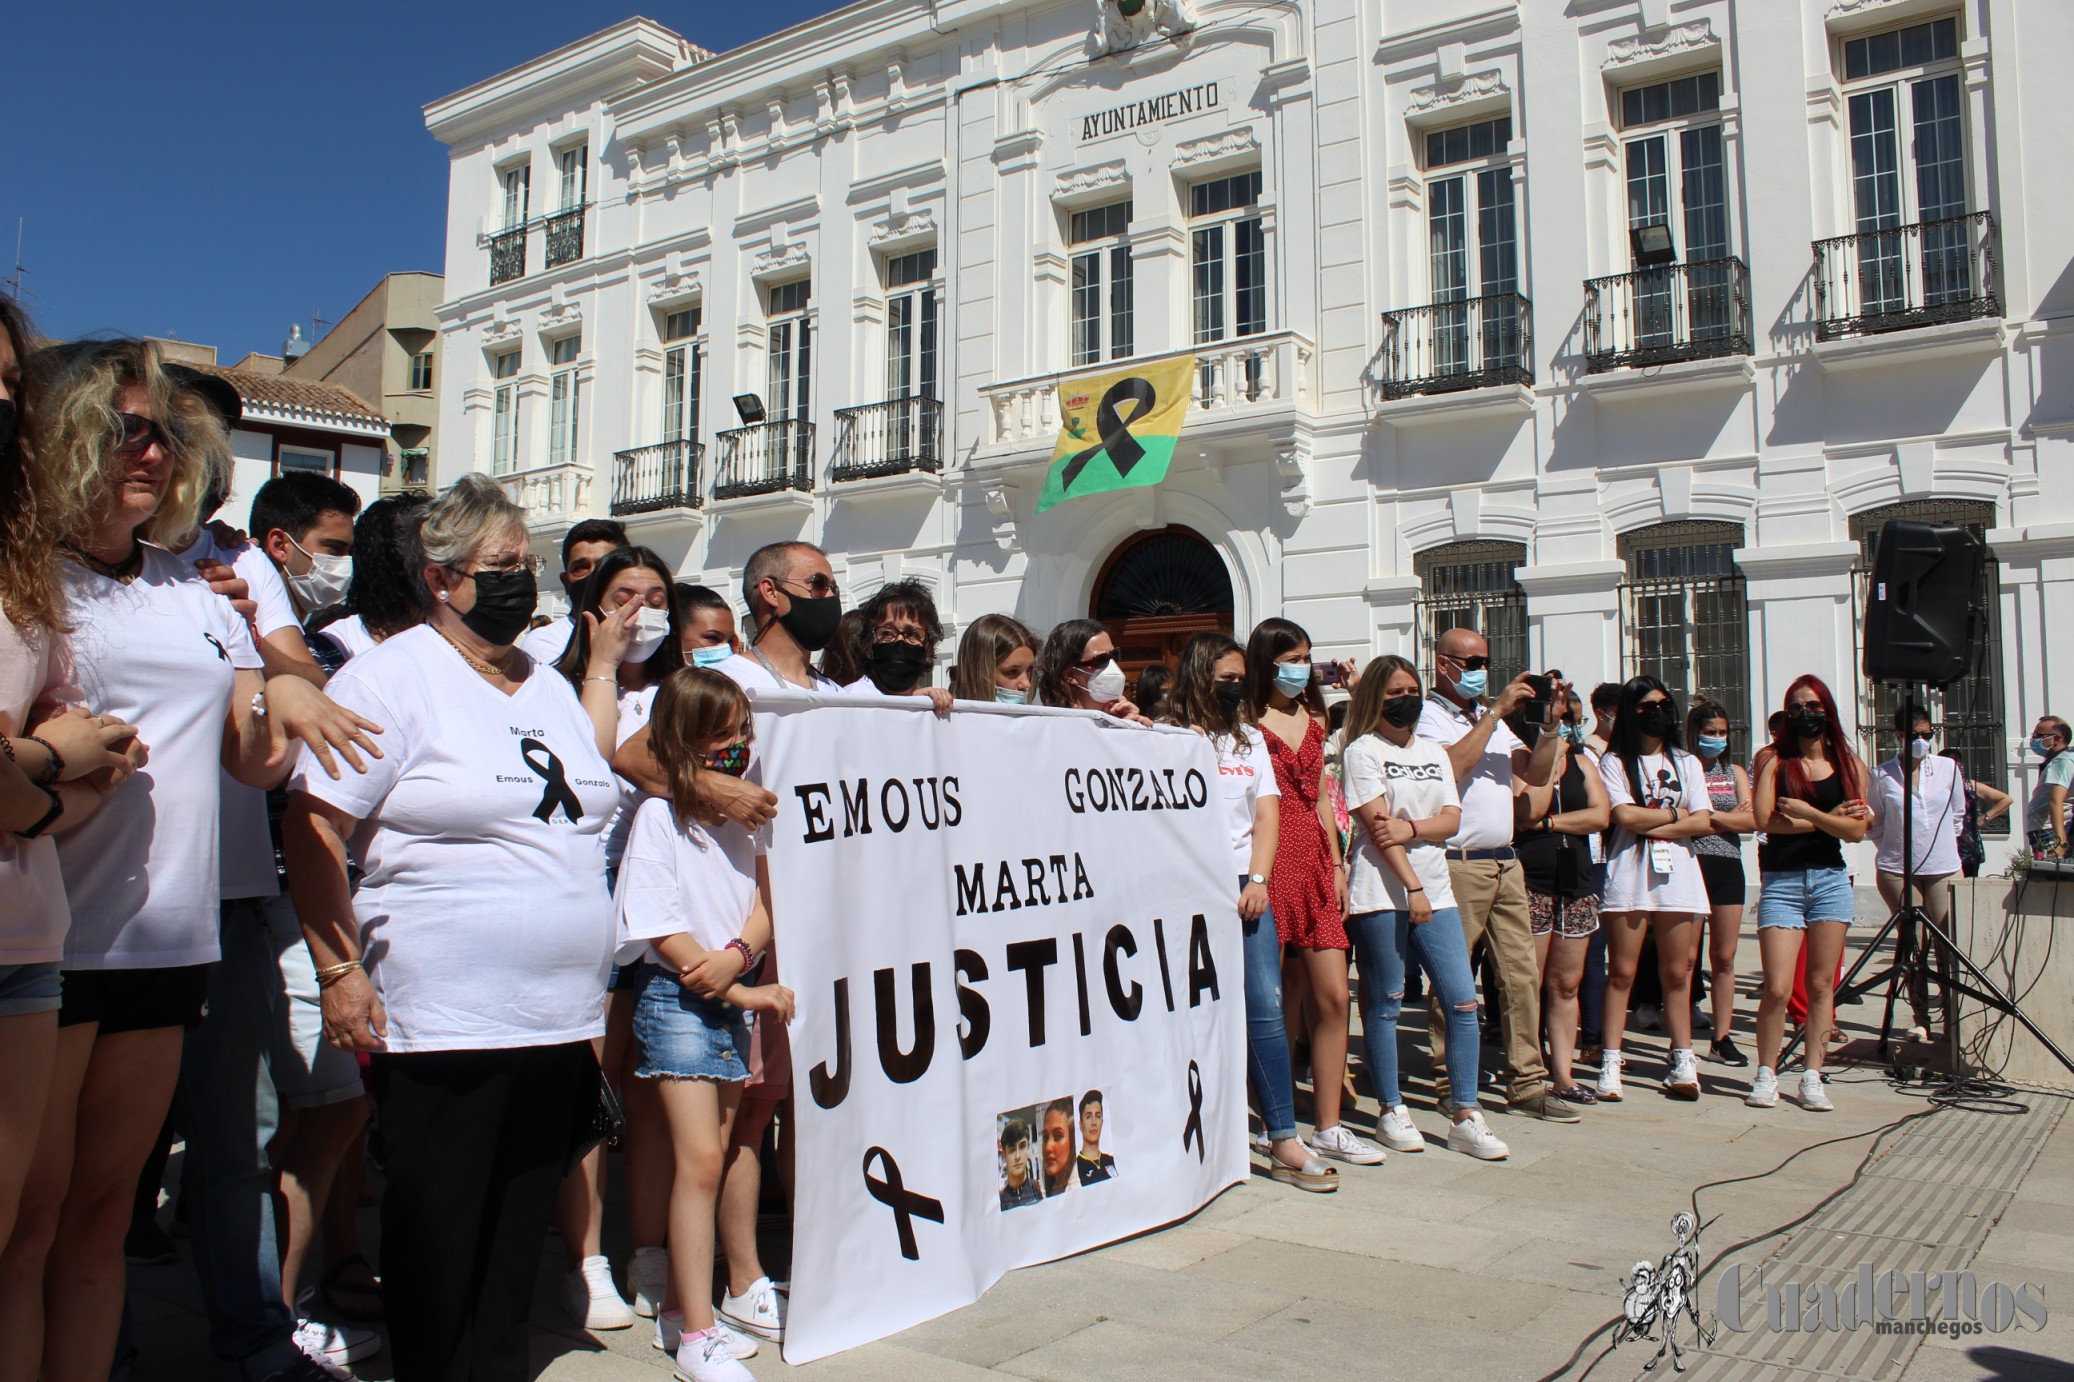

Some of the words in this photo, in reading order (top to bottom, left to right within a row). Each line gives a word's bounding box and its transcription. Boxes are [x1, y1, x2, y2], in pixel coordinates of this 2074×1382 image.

[1083, 83, 1219, 140] AYUNTAMIENTO
[510, 726, 545, 737] Marta
[496, 775, 534, 784] Emous
[1064, 767, 1207, 814] GONZALO
[1387, 765, 1442, 780] adidas
[794, 776, 962, 844] EMOUS
[954, 852, 1094, 916] MARTA
[809, 914, 1220, 1109] JUSTICIA
